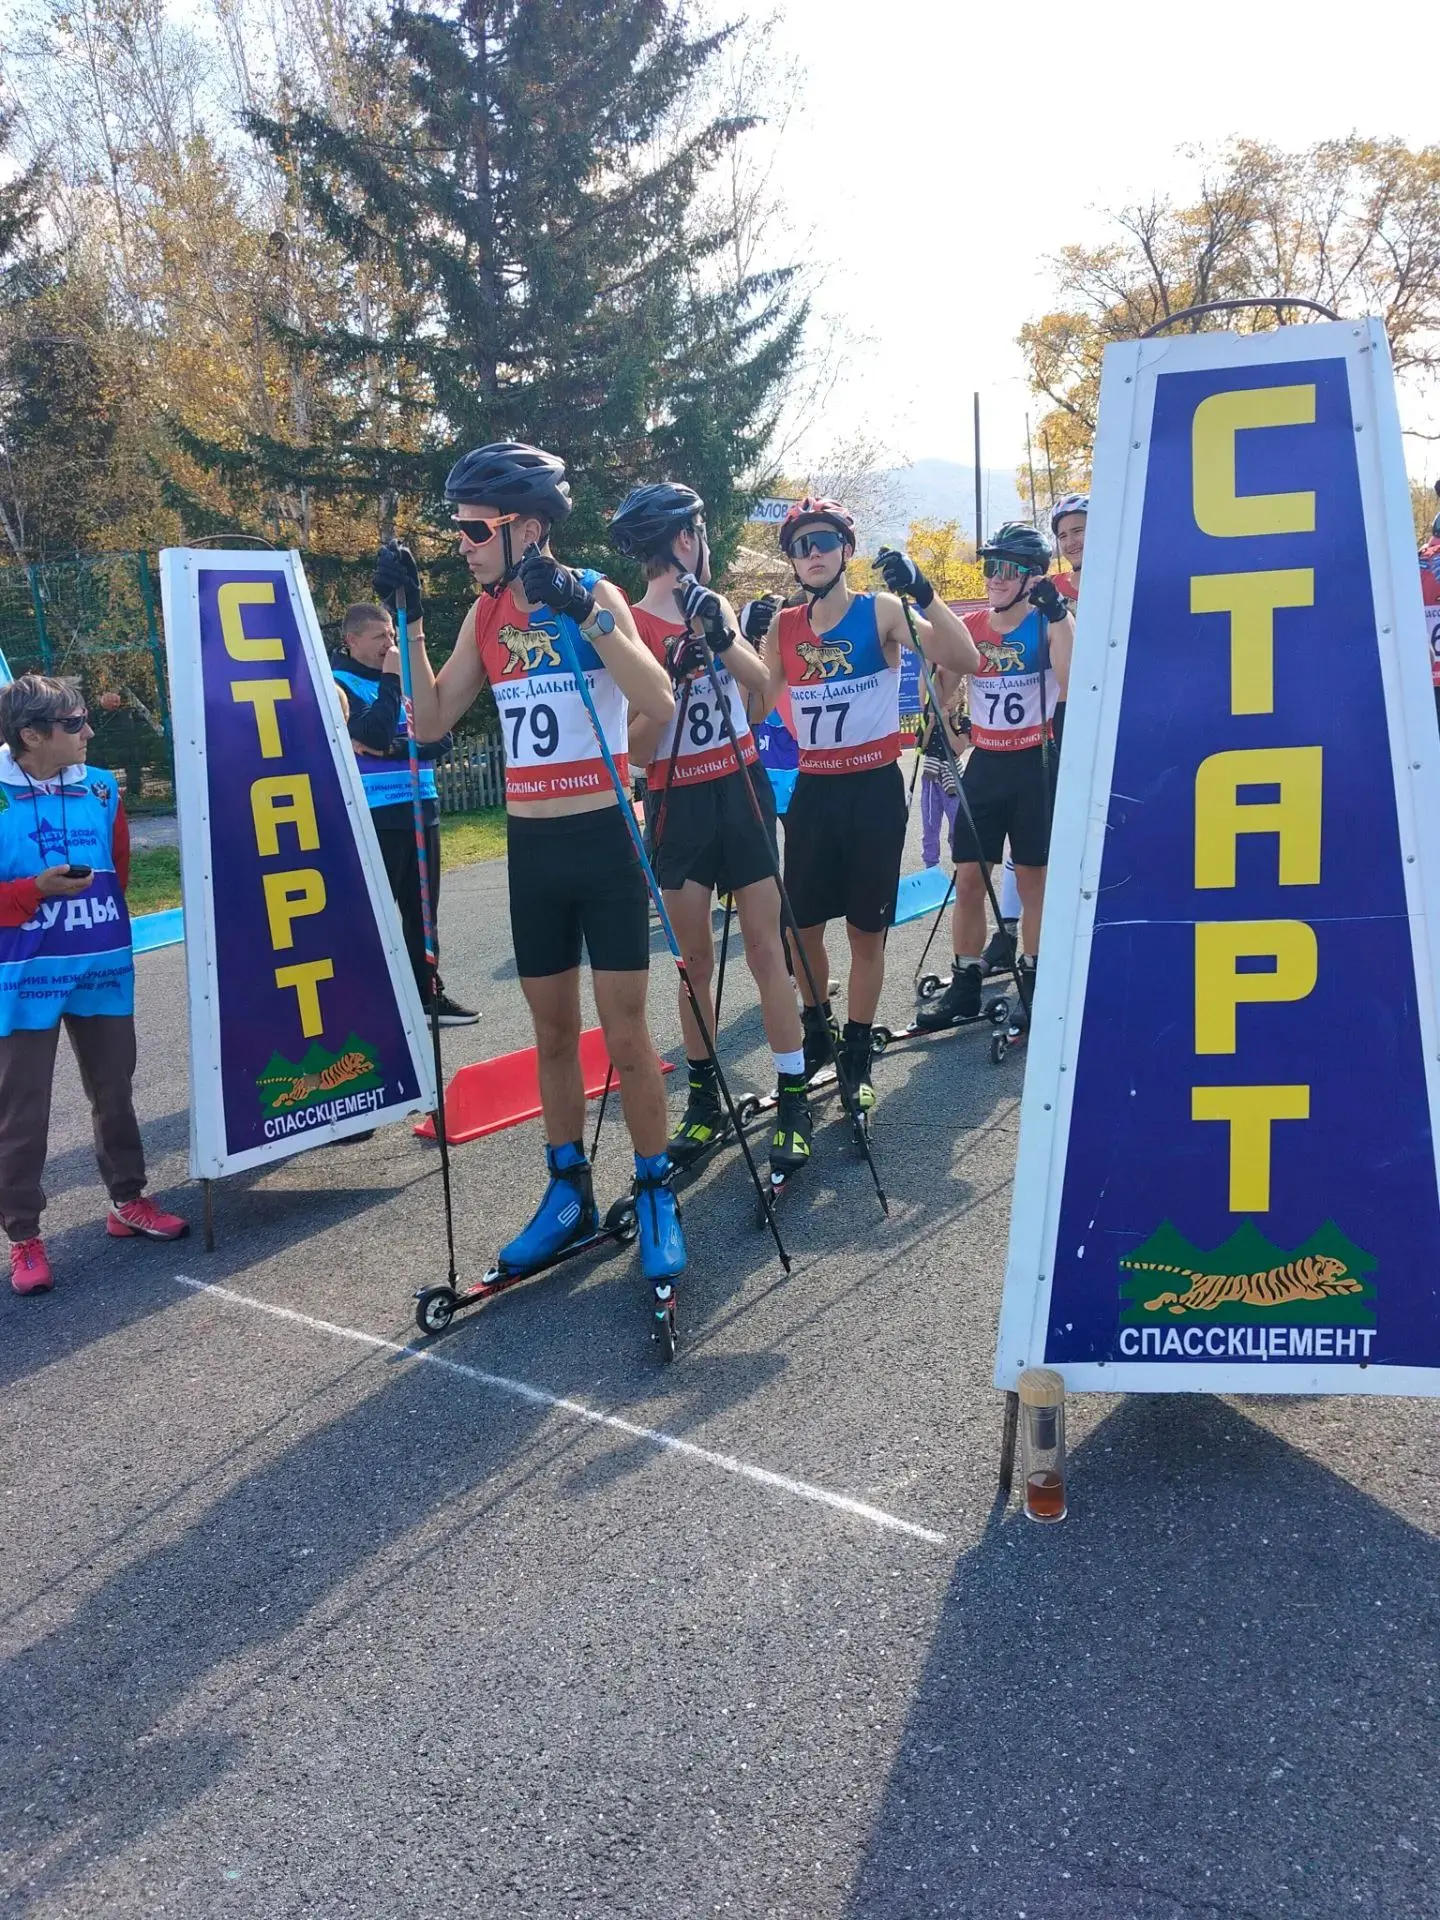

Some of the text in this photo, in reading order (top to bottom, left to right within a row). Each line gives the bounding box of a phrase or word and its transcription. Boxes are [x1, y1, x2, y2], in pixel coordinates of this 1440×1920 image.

[504, 703, 560, 760] 79
[687, 694, 732, 746] 82
[801, 702, 850, 745] 77
[984, 692, 1025, 725] 76
[217, 582, 334, 1038] СТАРТ
[1191, 384, 1323, 1212] СТАРТ
[264, 1087, 385, 1138] СПАССКЦЕМЕНТ
[1119, 1327, 1377, 1361] СПАССКЦЕМЕНТ
